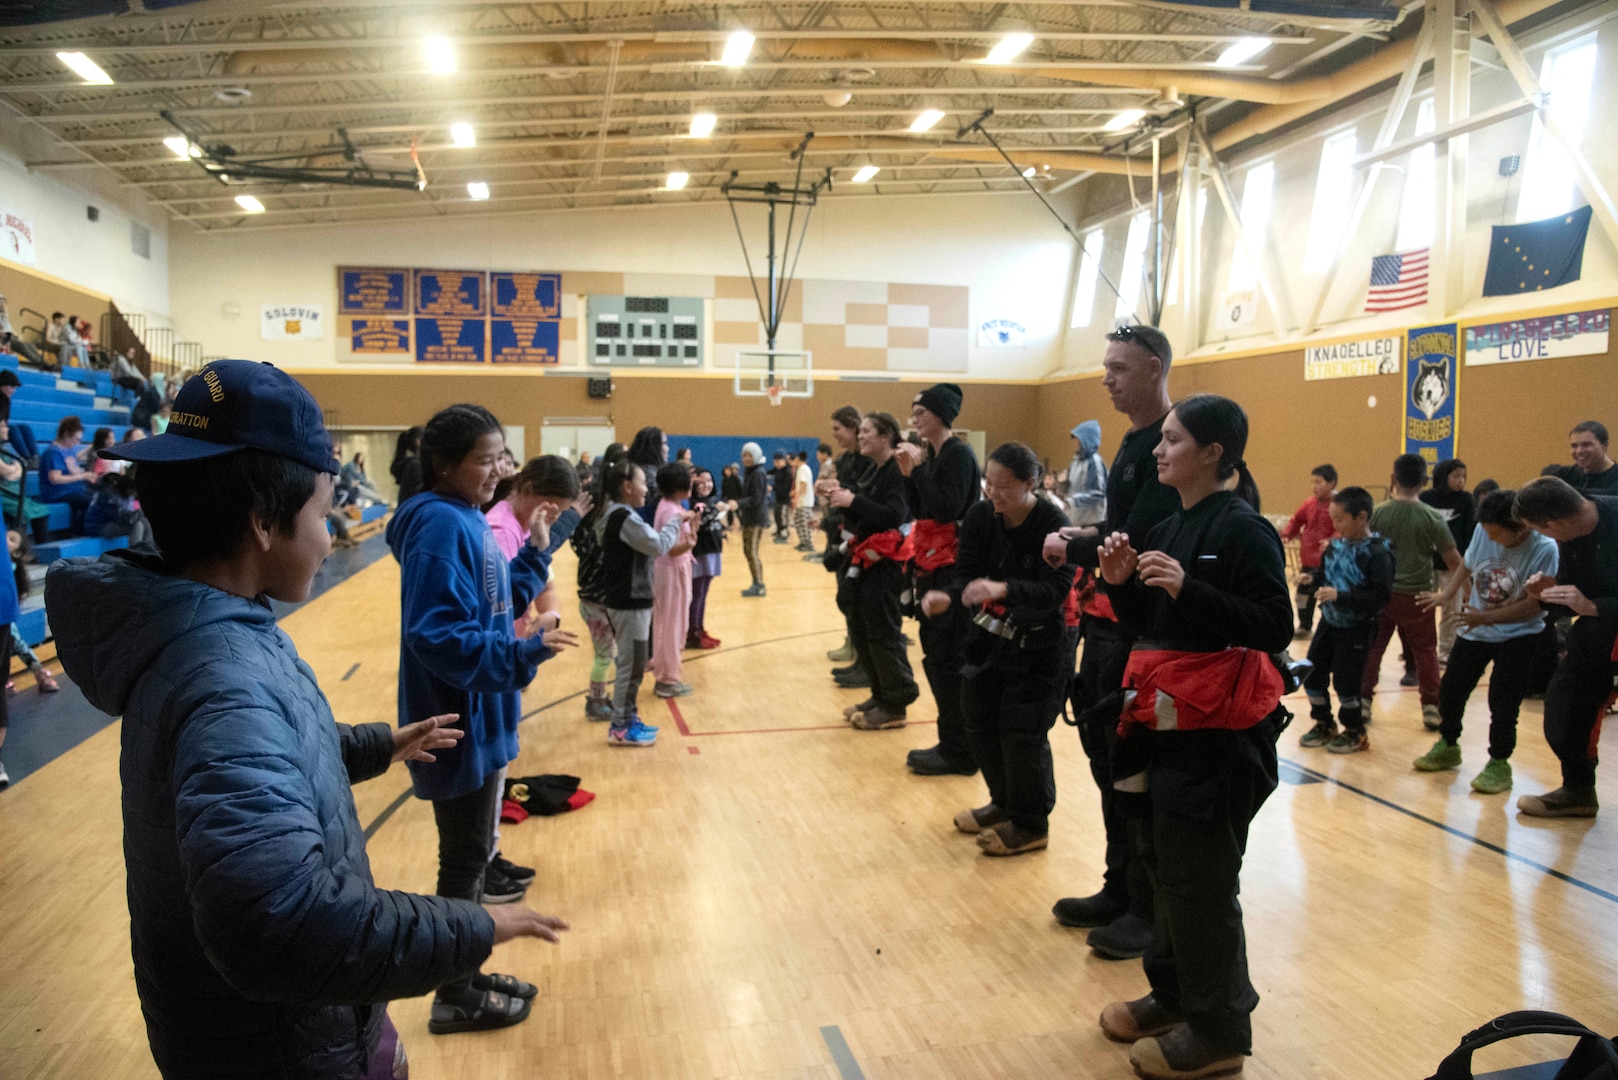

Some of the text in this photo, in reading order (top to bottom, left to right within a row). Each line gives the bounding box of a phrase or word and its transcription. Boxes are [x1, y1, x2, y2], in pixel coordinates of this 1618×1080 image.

[1499, 337, 1549, 360] LOVE
[1307, 359, 1377, 379] STRENGTH
[203, 370, 225, 403] GUARD
